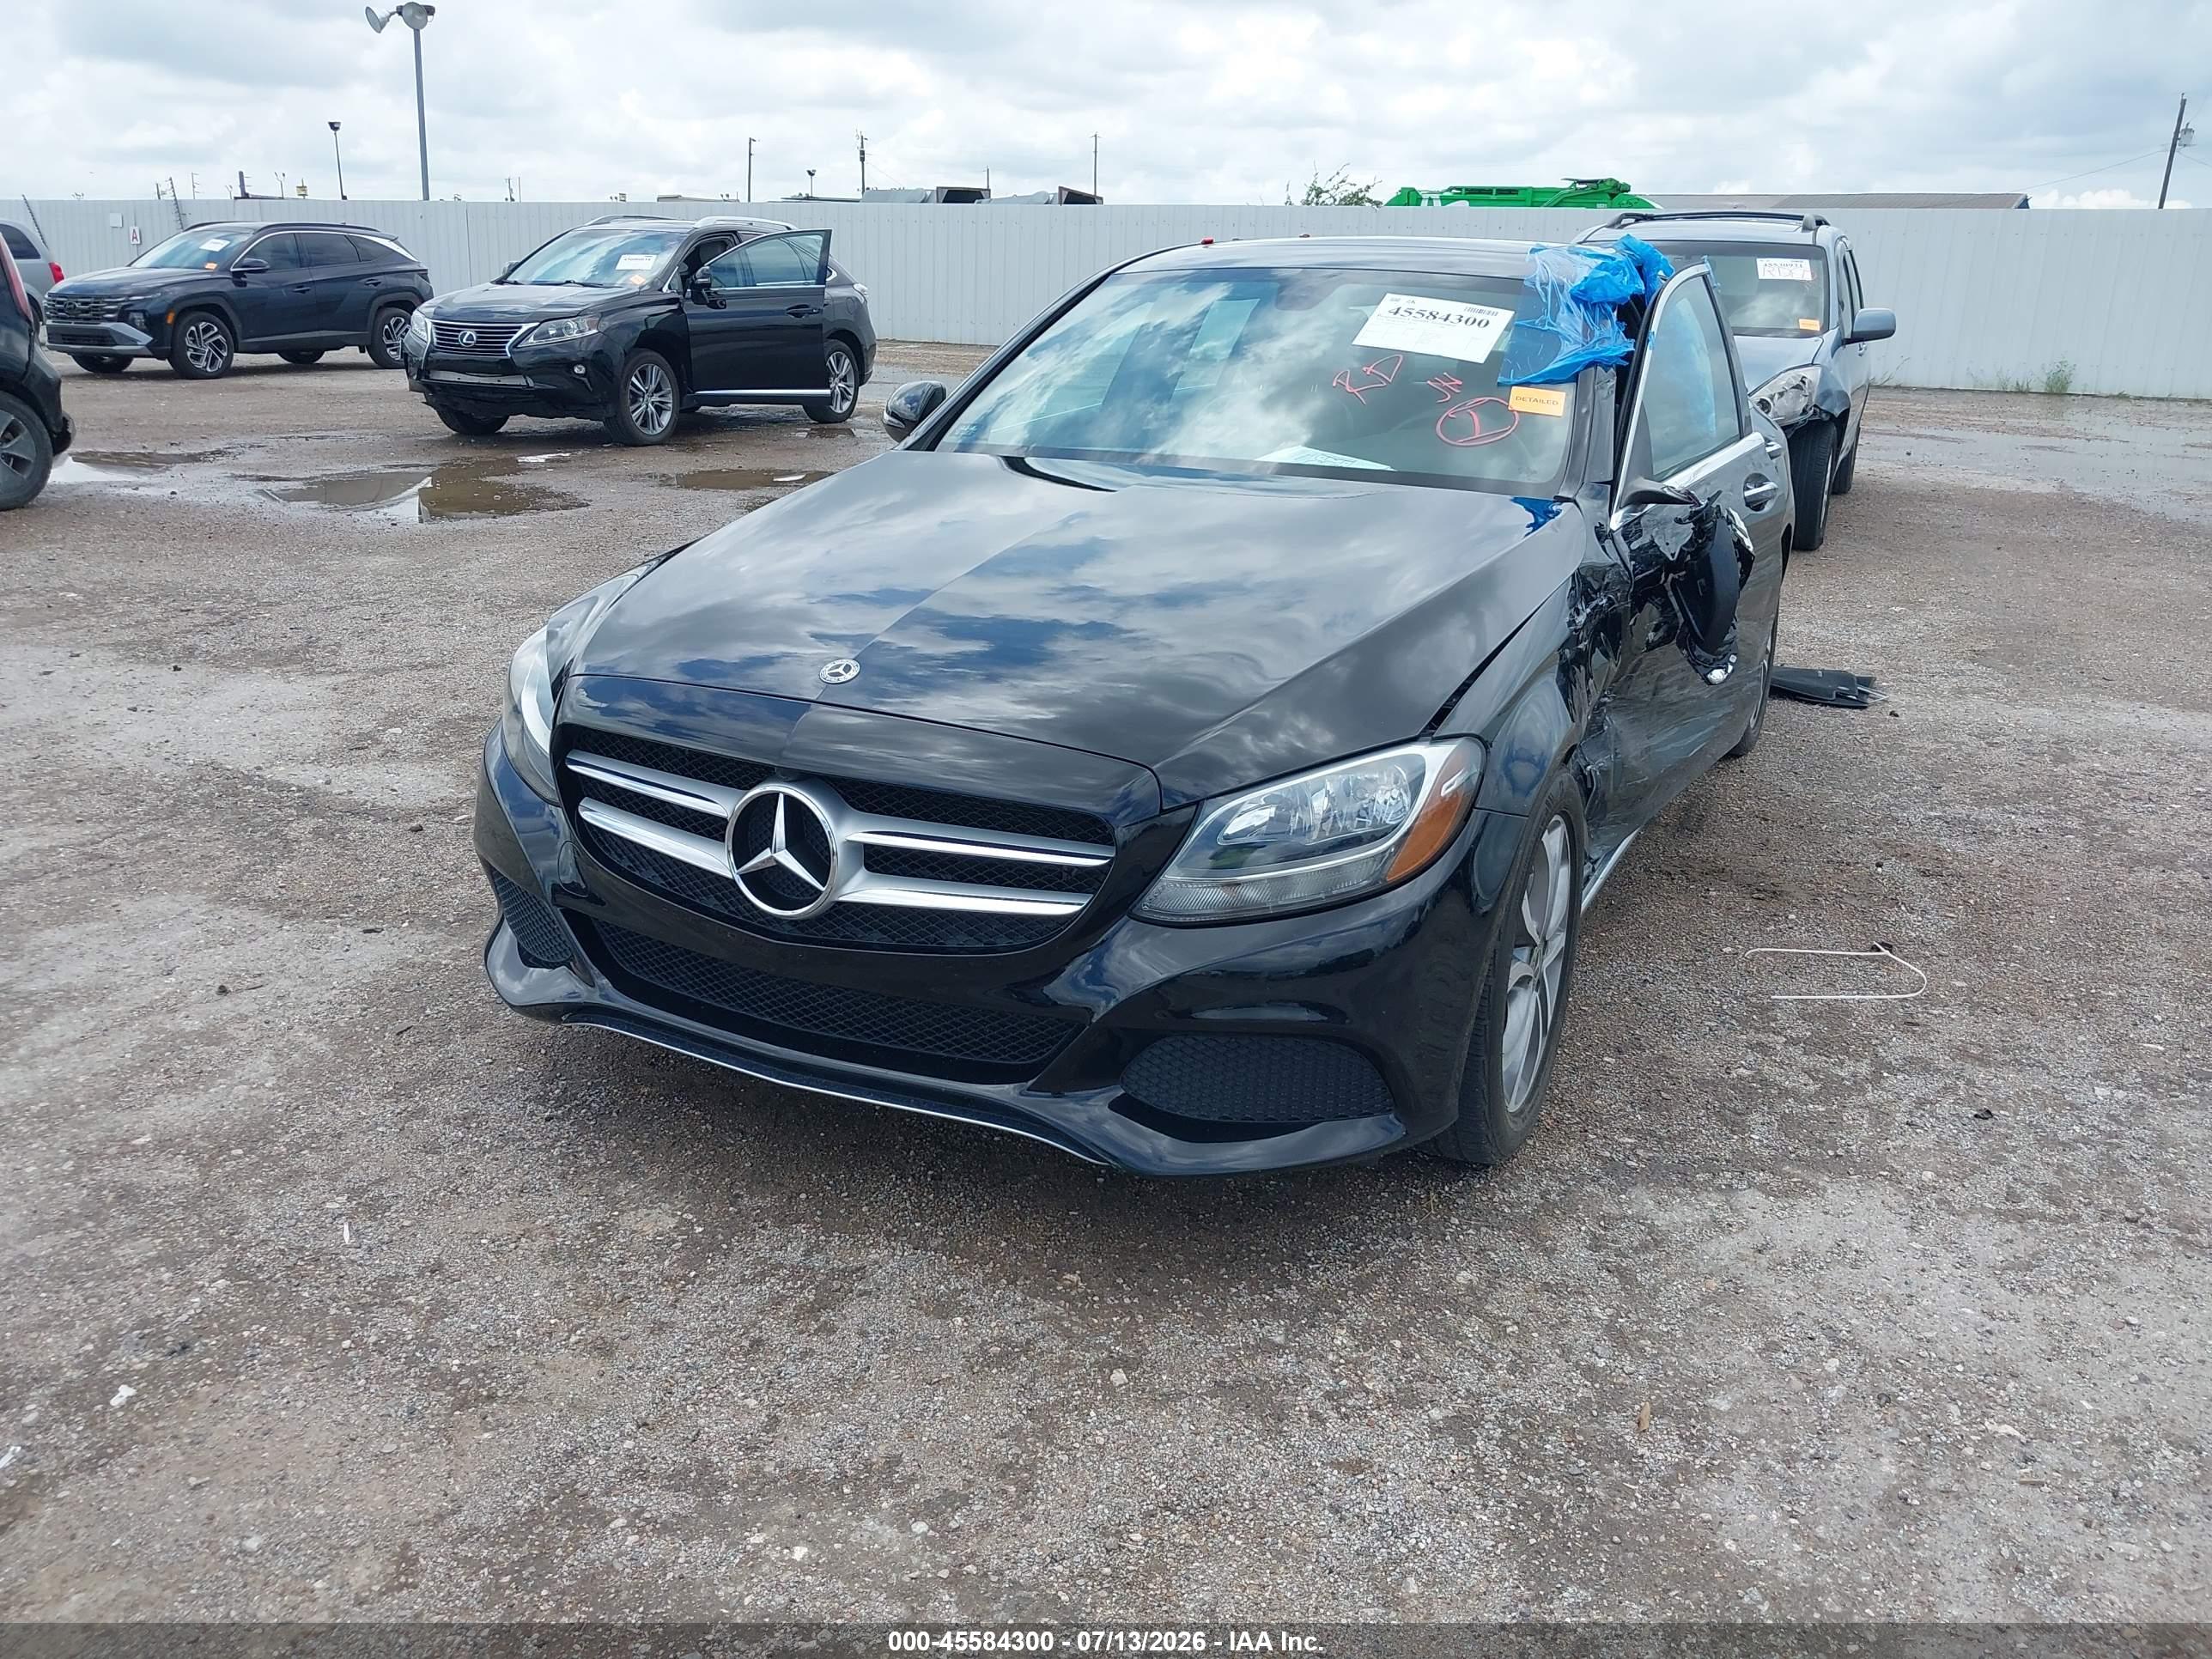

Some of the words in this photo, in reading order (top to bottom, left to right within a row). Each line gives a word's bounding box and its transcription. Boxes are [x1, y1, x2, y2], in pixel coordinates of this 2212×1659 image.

[131, 228, 138, 242] A
[1388, 306, 1490, 329] 45584300
[1515, 396, 1559, 406] DETAILED
